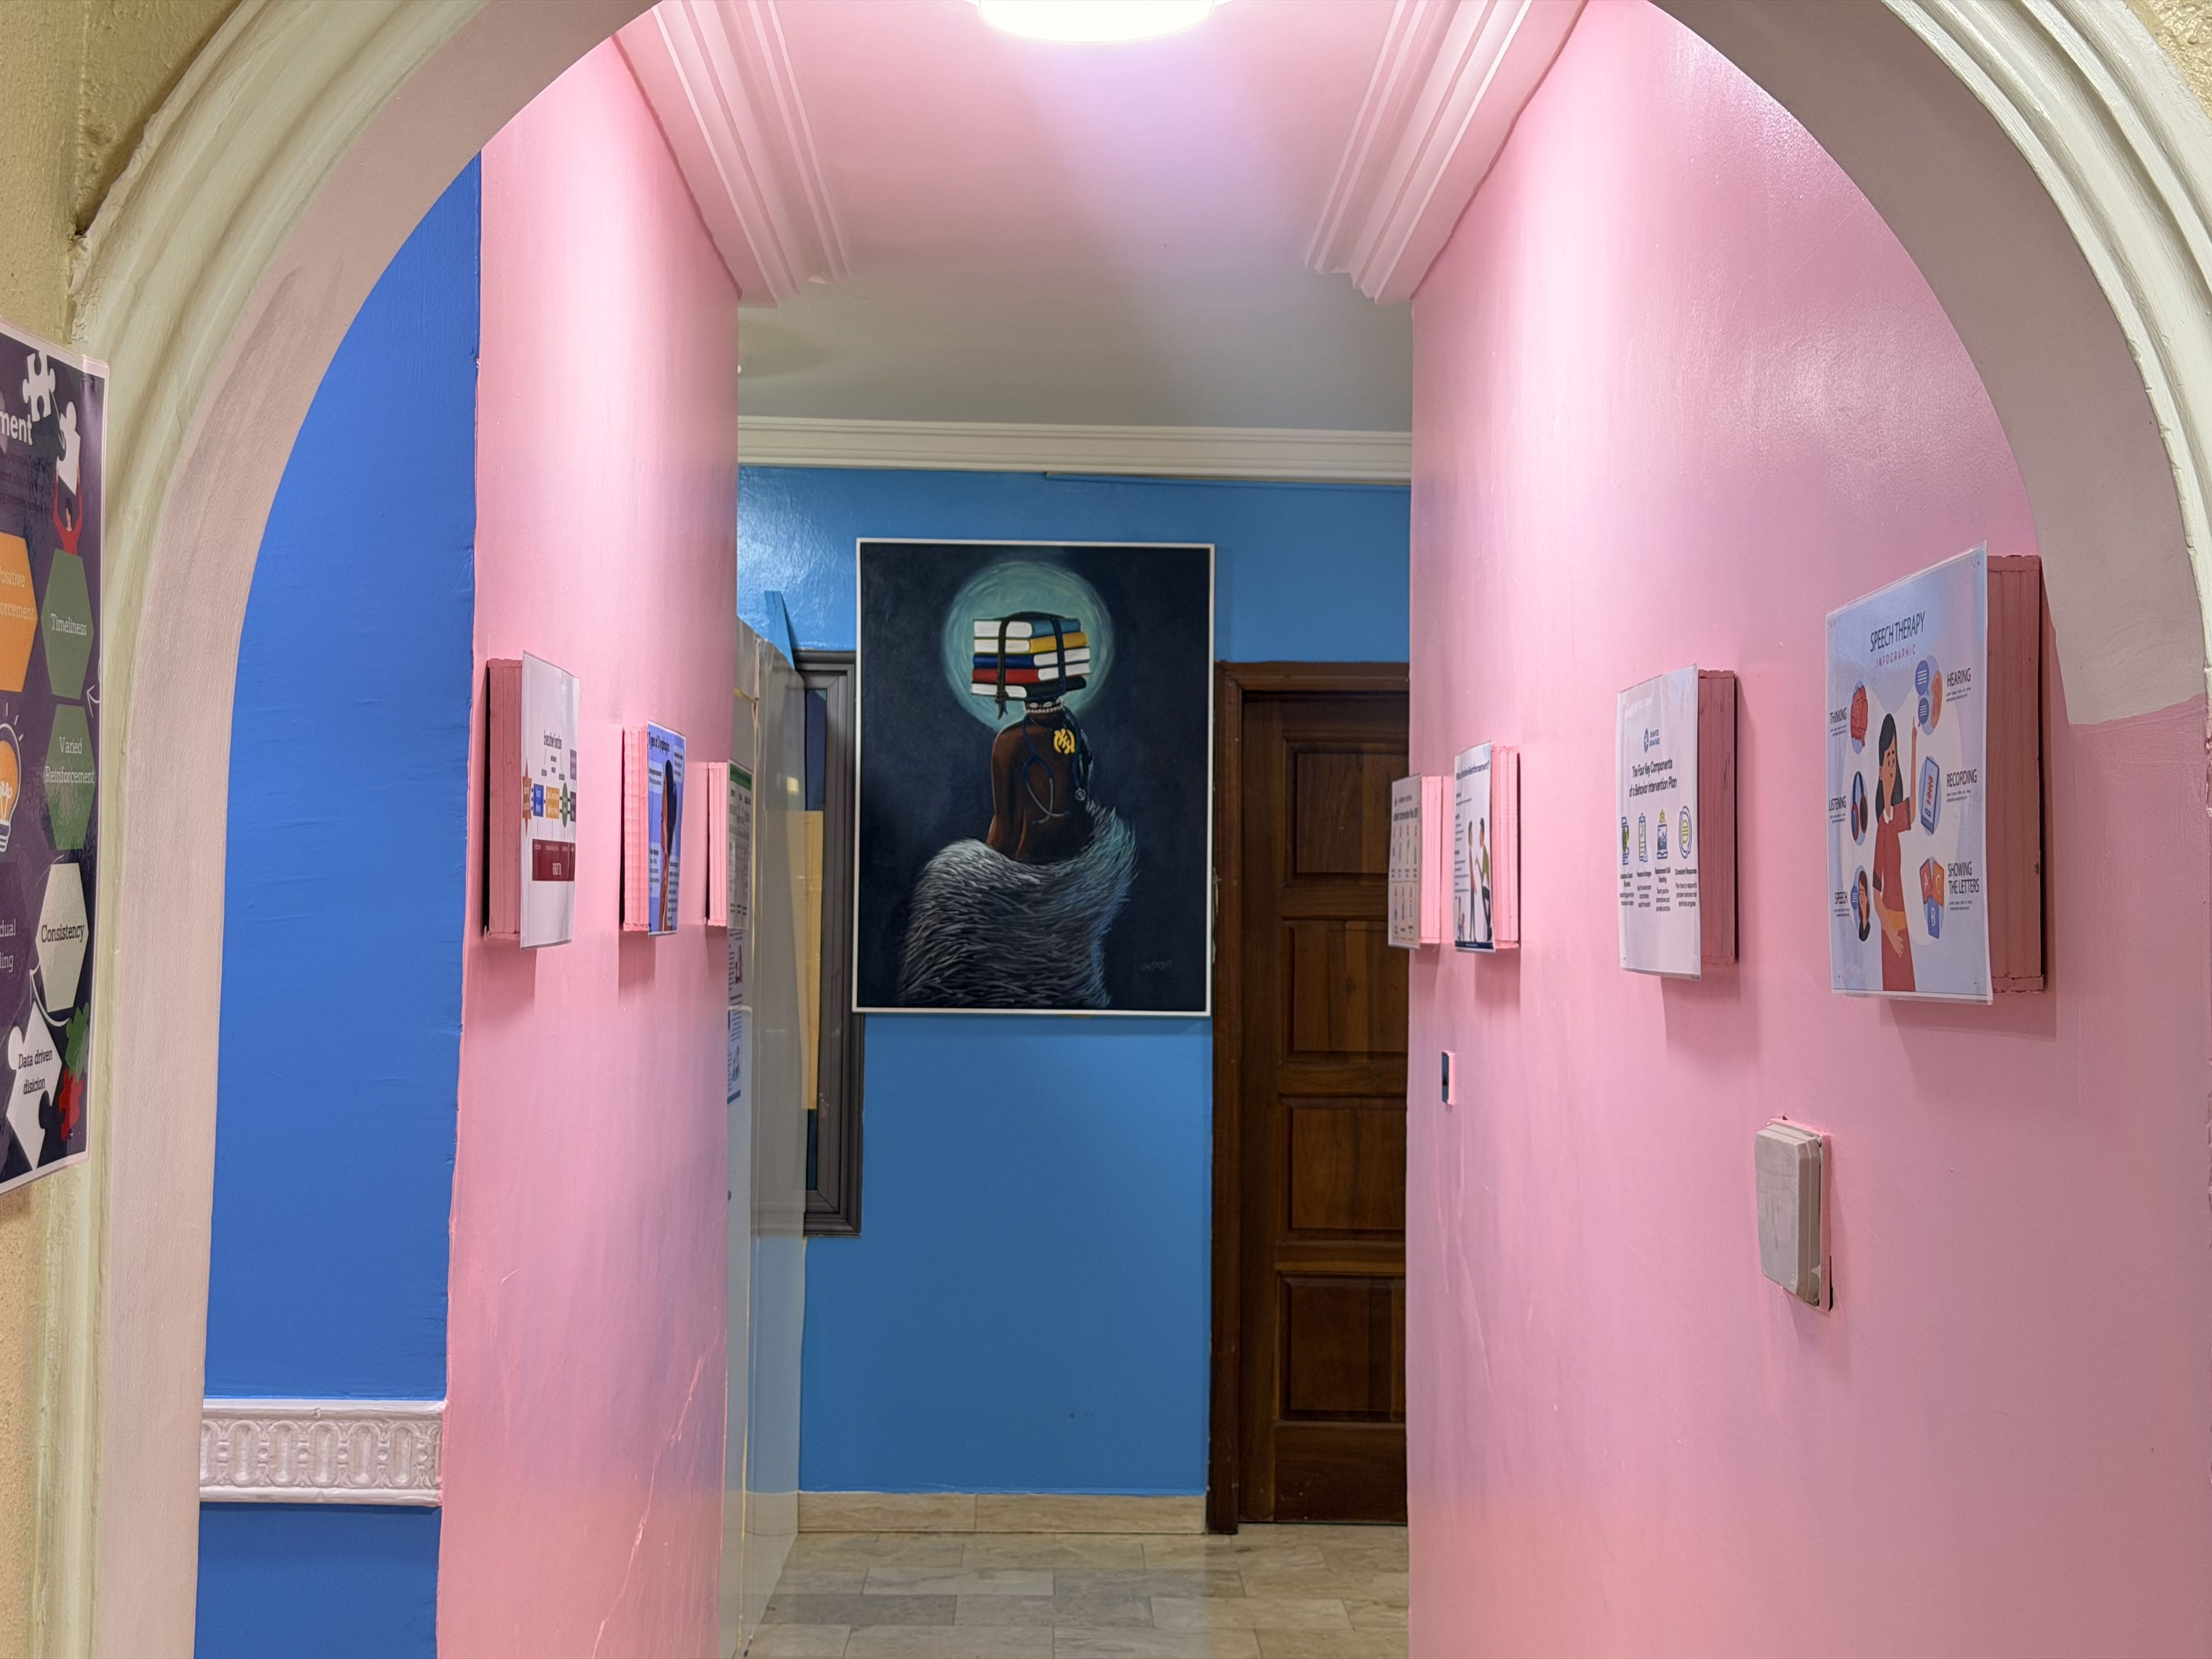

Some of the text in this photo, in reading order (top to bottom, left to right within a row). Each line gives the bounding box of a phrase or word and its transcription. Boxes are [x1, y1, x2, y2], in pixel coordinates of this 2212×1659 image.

[0, 565, 25, 588] ositive
[51, 613, 87, 636] Timeliness
[1870, 611, 1925, 653] SPEECH THERAPY
[1876, 644, 1916, 668] INFOGRAPHIC
[1946, 667, 1971, 687] HEARING
[1830, 707, 1847, 724] THINKING
[59, 737, 82, 754] Varied
[44, 765, 94, 784] Reinforcement
[1651, 757, 1673, 775] Components
[1648, 777, 1668, 793] Intervention
[1668, 775, 1677, 789] Plan
[1946, 768, 1977, 788] RECORDING
[1829, 795, 1846, 811] LISTENING
[1948, 861, 1972, 877] SHOWING
[1948, 878, 1979, 894] THE LETTERS
[1835, 891, 1848, 904] SPEECH
[41, 924, 85, 943] Consistency
[18, 1049, 53, 1069] Data driven
